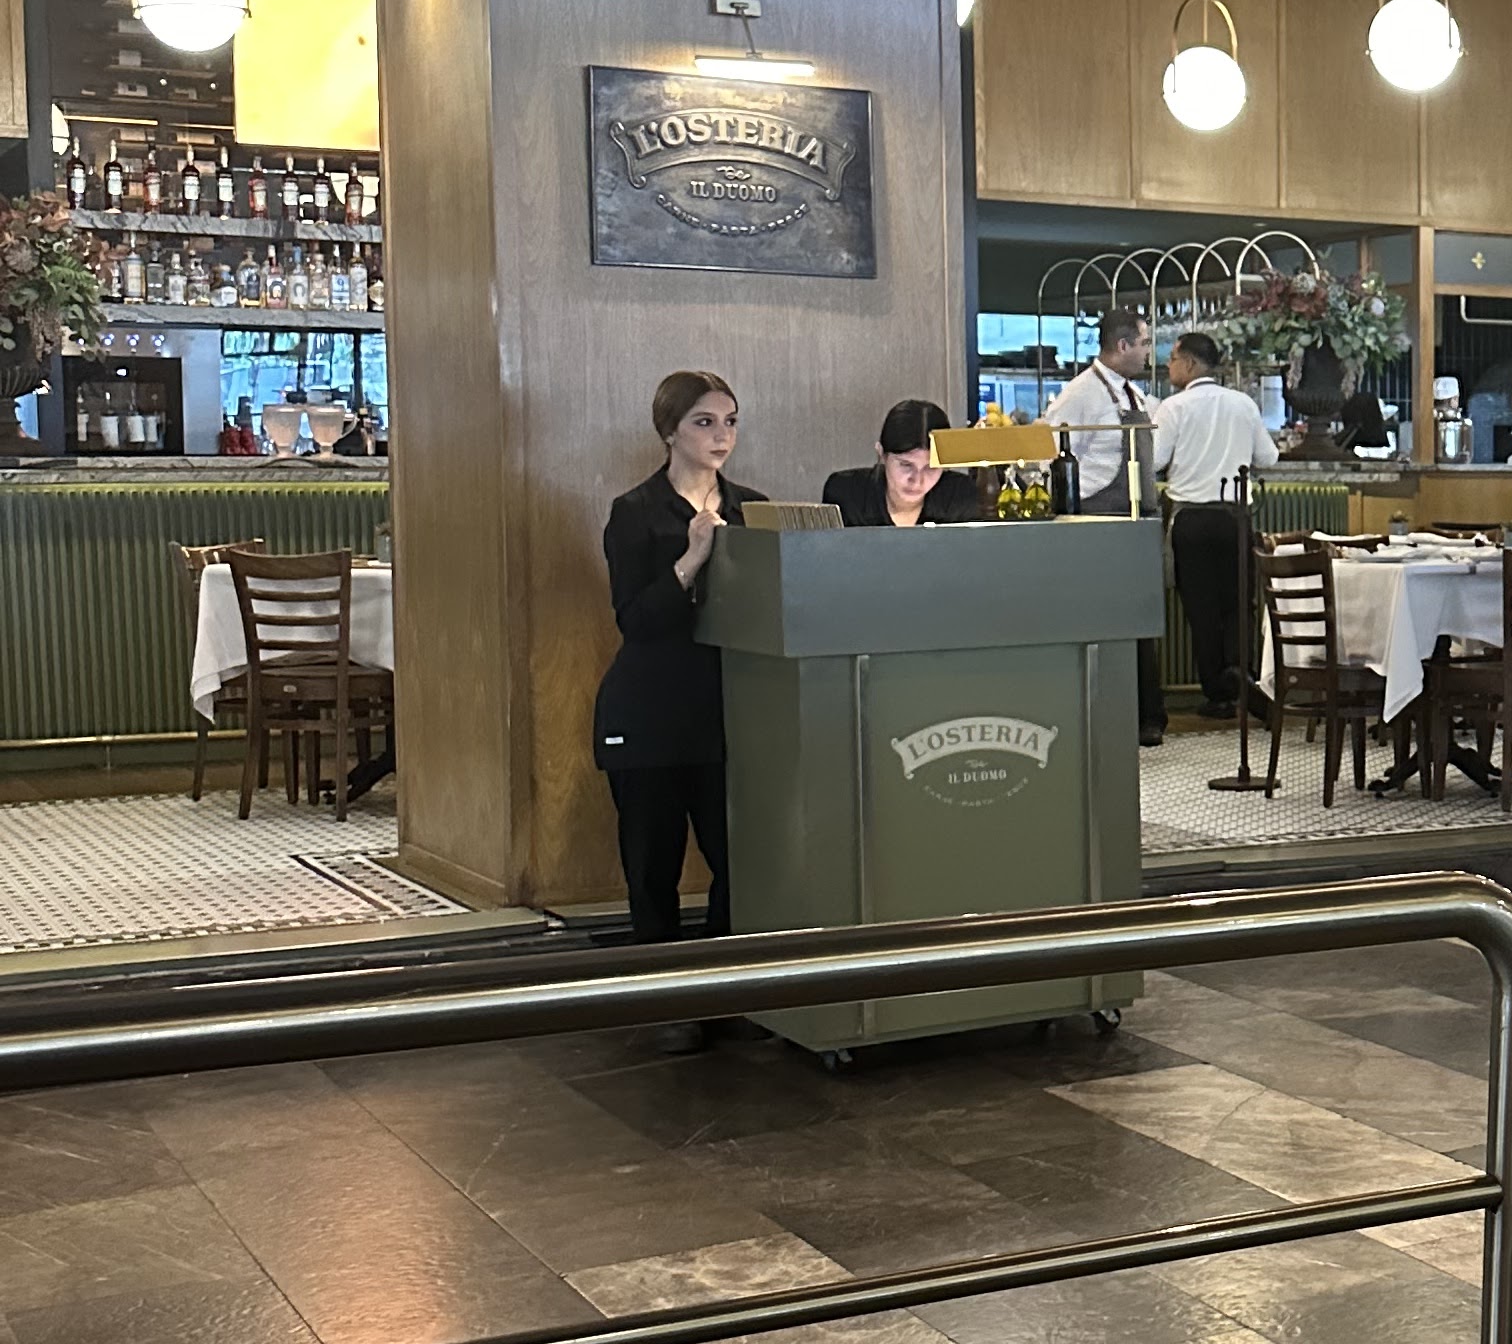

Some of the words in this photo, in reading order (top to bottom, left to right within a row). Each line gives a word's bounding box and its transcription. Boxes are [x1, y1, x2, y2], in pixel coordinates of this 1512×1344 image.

[629, 112, 827, 173] L'OSTERIA
[690, 181, 709, 197] IL
[712, 183, 777, 202] DUOMO
[907, 724, 1040, 761] L'OSTERIA
[947, 773, 960, 784] IL
[963, 769, 1007, 783] DUOMO
